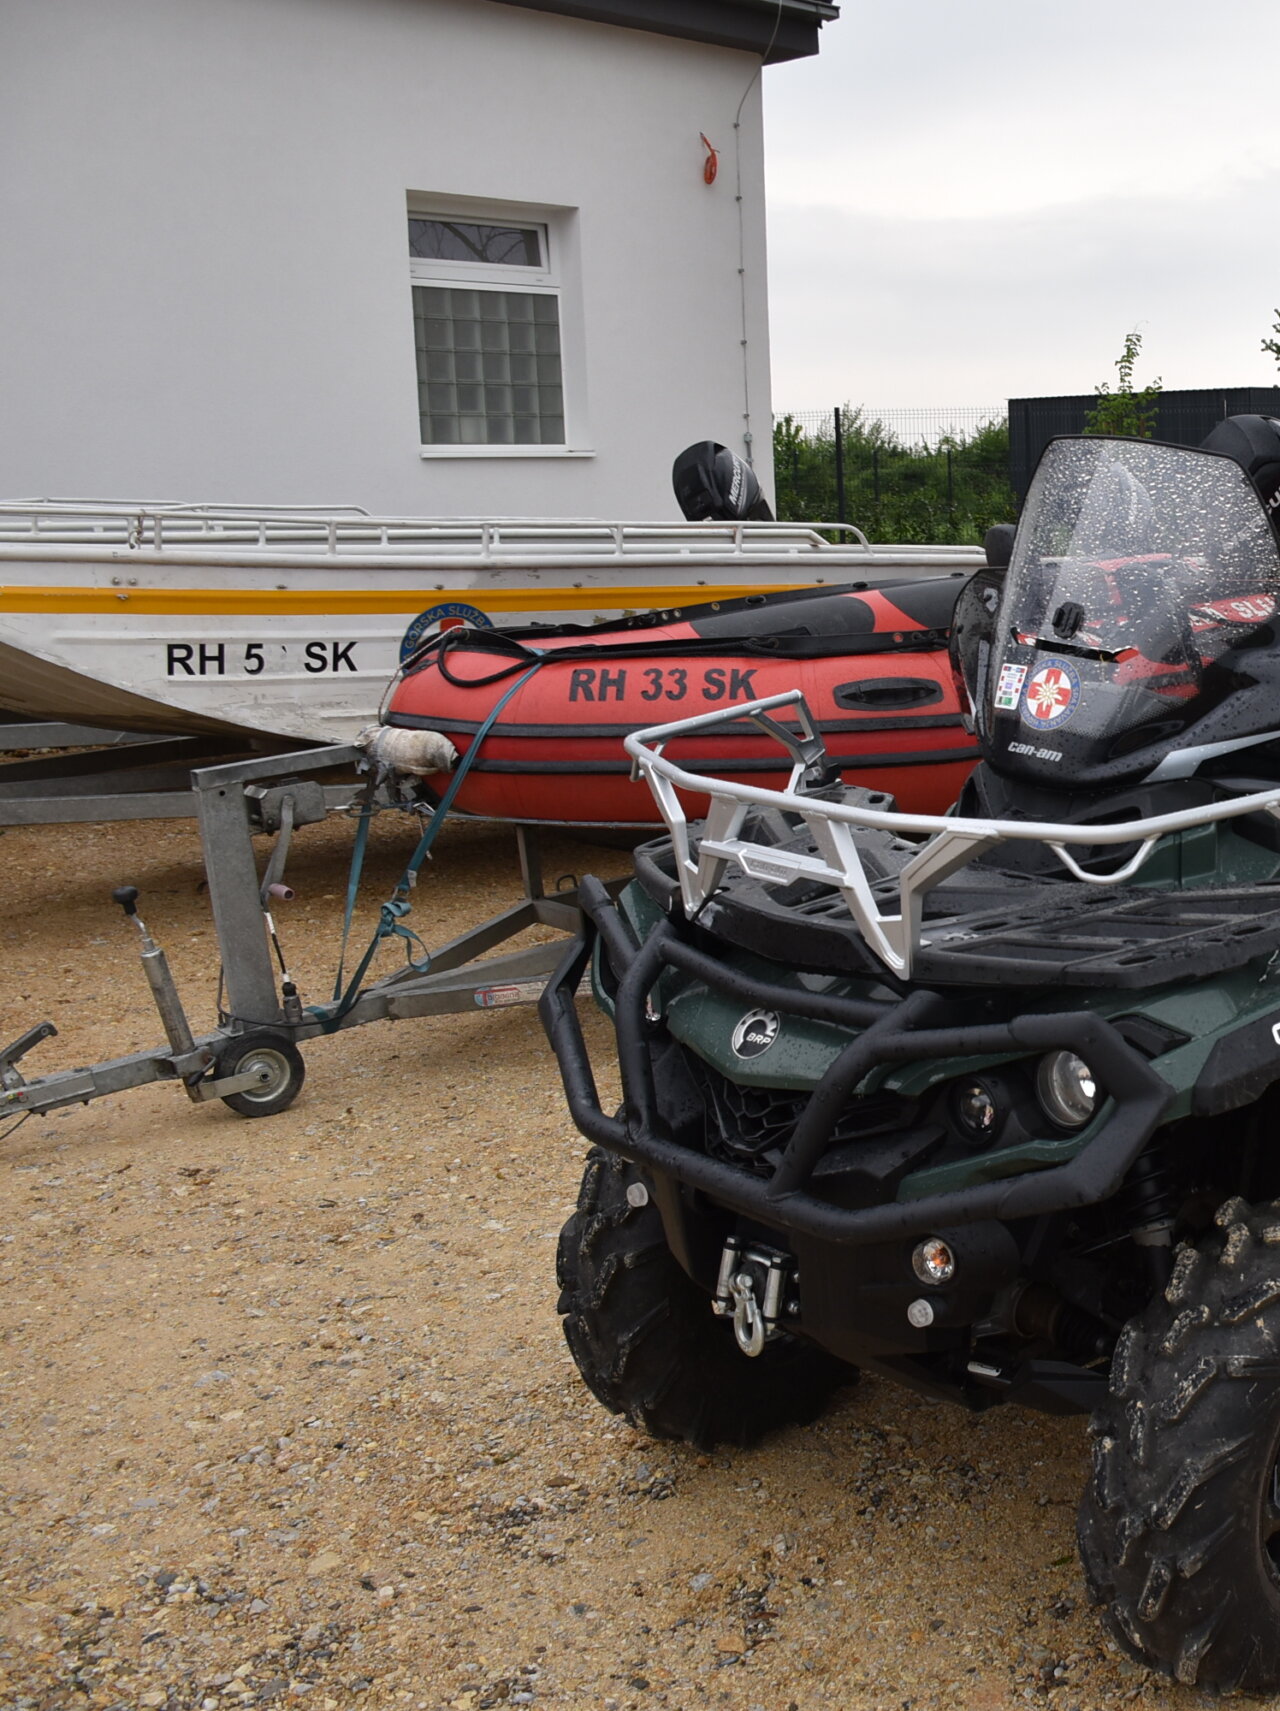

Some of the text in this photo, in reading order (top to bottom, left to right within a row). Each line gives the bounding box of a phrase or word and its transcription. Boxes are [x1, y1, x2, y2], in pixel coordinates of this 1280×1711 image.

[404, 608, 446, 649] GORSKA
[167, 642, 225, 676] RH
[303, 641, 359, 673] SK
[569, 667, 758, 702] RH 33 SK
[1007, 741, 1063, 762] can-am
[745, 1031, 772, 1045] BRP
